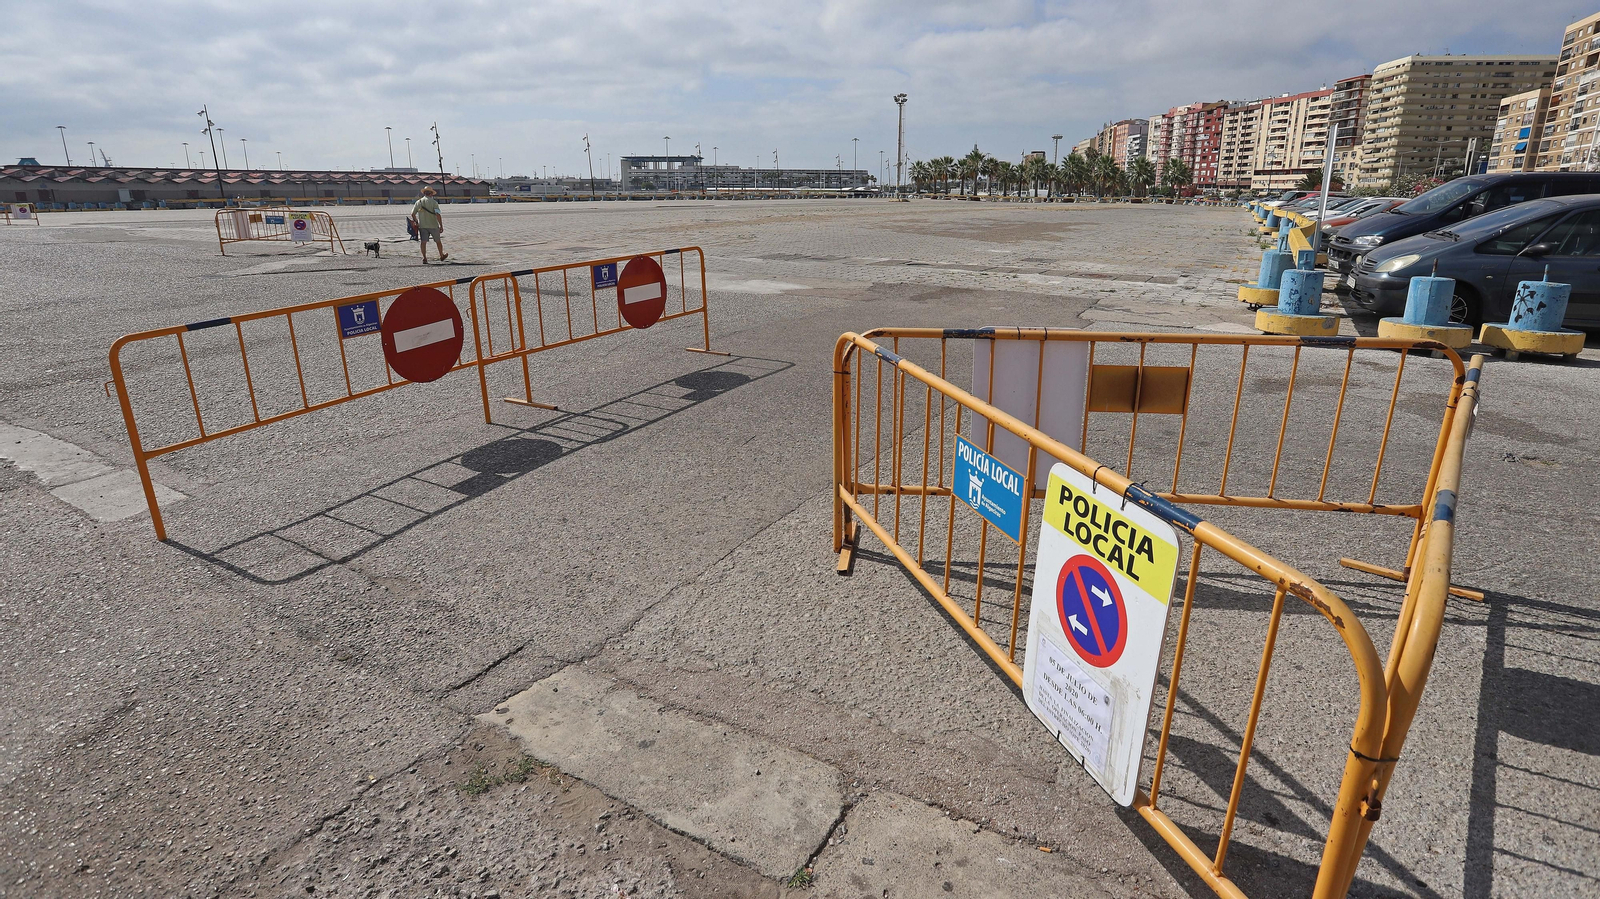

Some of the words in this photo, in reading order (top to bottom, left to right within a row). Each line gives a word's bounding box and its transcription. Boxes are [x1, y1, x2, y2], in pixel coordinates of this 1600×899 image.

[958, 441, 989, 476] POLICÍA
[991, 462, 1019, 496] LOCAL
[1059, 484, 1154, 564] POLICIA
[1064, 512, 1140, 582] LOCAL
[1044, 672, 1063, 696] DESDE
[1064, 693, 1077, 709] LAS
[1056, 664, 1065, 676] DE
[1066, 673, 1086, 695] JULIO
[1088, 692, 1098, 706] DE
[1065, 683, 1078, 699] 2020
